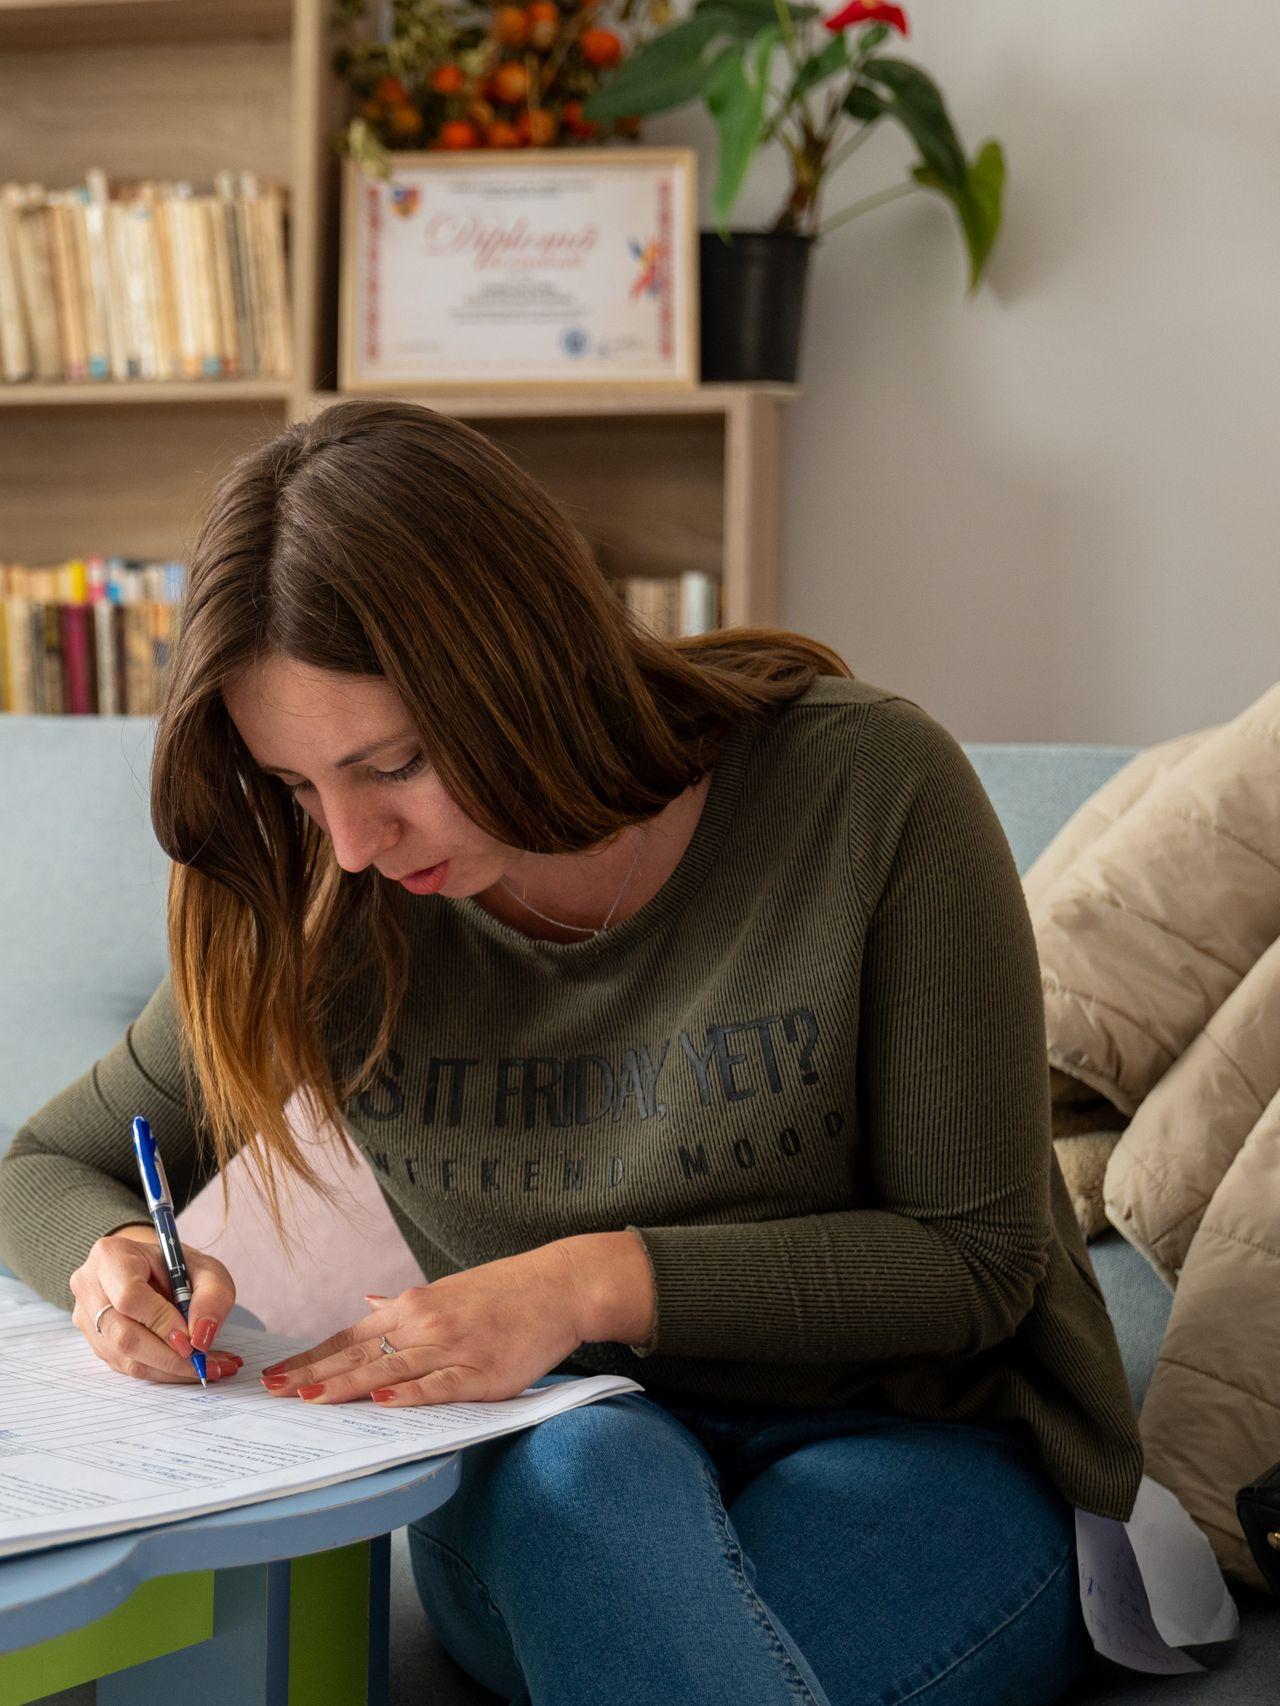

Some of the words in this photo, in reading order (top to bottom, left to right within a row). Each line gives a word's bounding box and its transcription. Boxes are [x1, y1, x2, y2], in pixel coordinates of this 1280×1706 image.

[422, 1057, 480, 1126] IT
[495, 1038, 670, 1129] FRIDAY,
[677, 1007, 818, 1107] YET?
[677, 1110, 845, 1180] MOOD
